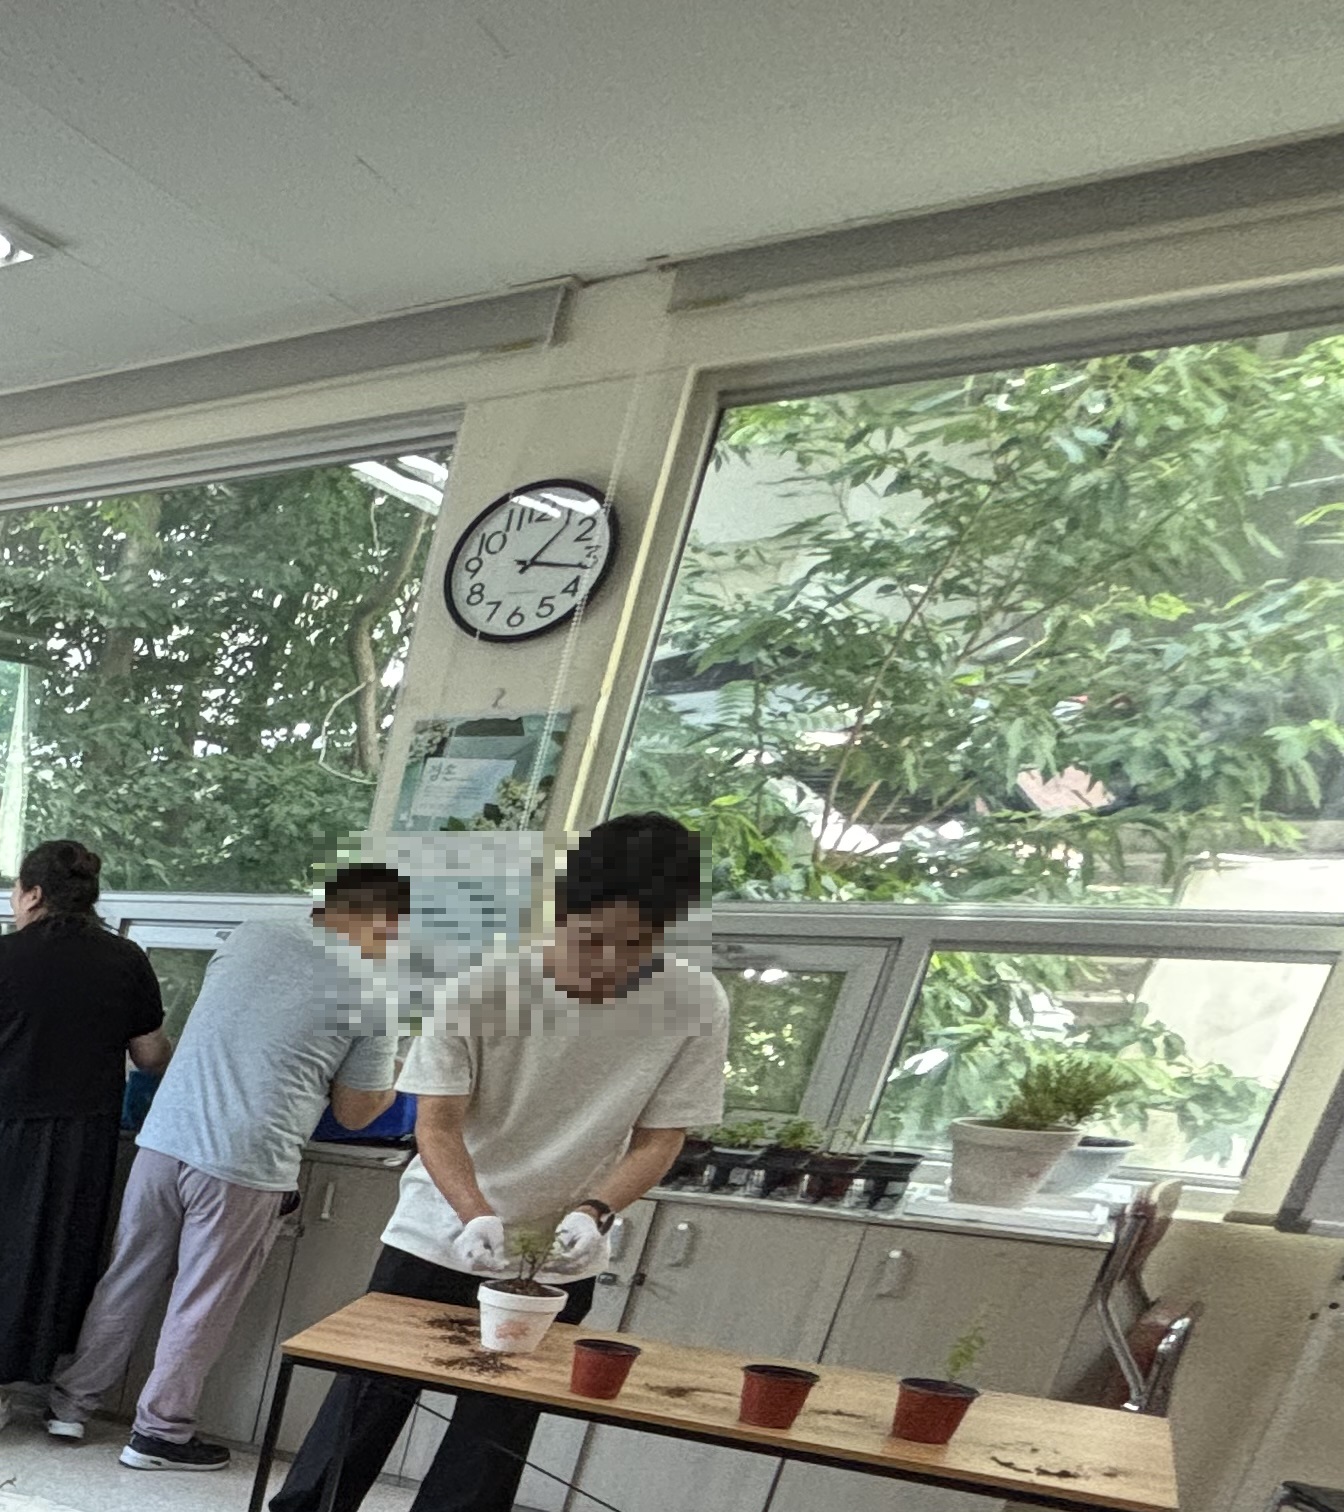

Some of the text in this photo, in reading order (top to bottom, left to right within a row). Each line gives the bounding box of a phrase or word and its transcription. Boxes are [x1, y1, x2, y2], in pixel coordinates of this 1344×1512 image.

[505, 507, 526, 533] 11
[573, 516, 597, 542] 2
[478, 530, 508, 557] 10
[465, 556, 483, 579] 9
[466, 582, 485, 606] 8
[560, 575, 581, 597] 4
[485, 600, 502, 622] 7
[506, 606, 525, 627] 6
[536, 595, 557, 618] 5
